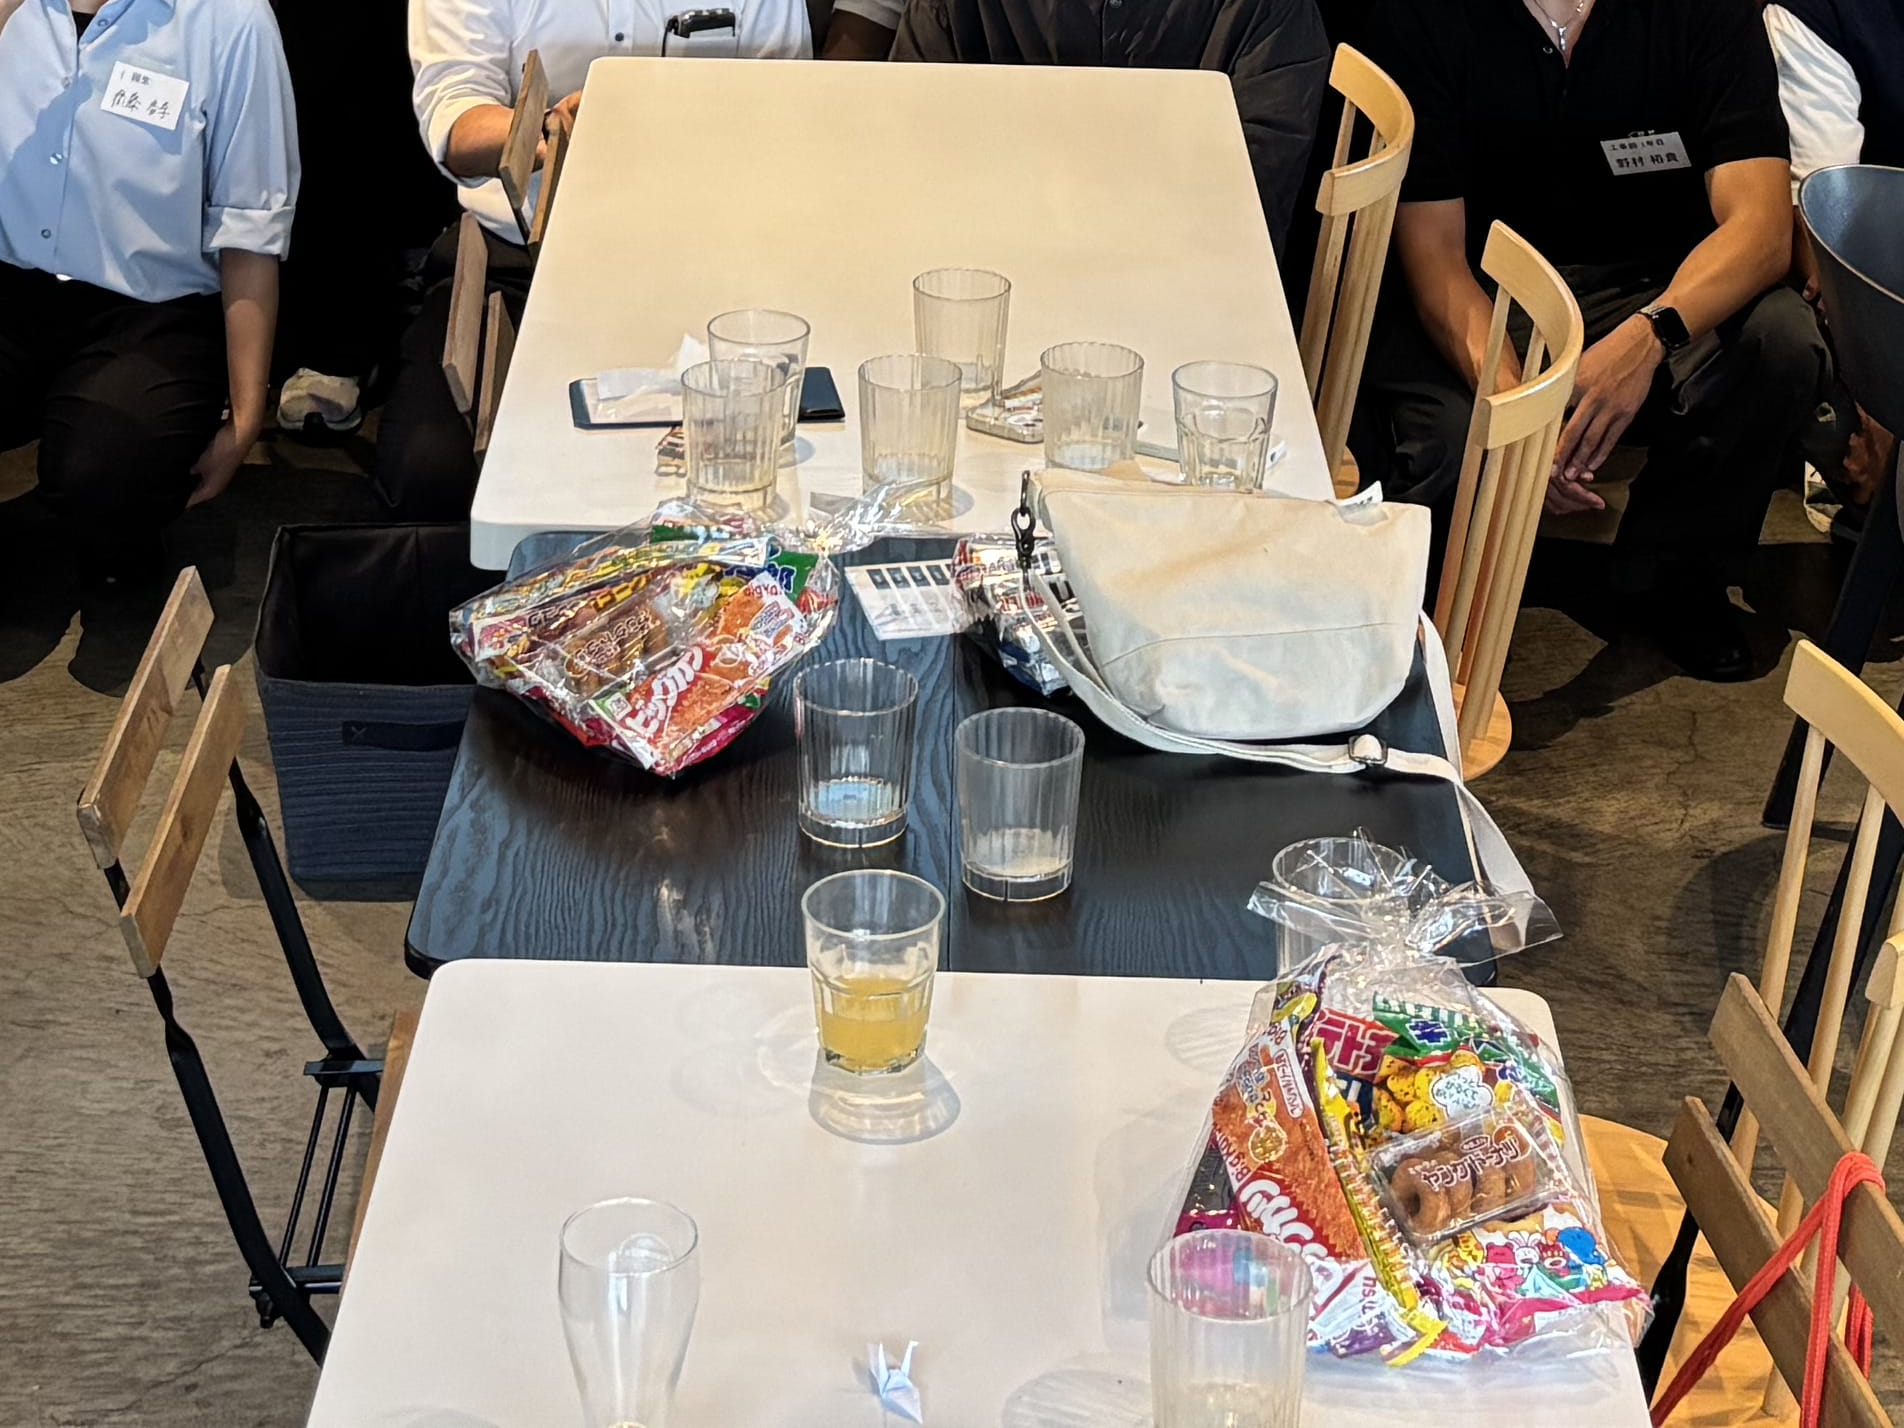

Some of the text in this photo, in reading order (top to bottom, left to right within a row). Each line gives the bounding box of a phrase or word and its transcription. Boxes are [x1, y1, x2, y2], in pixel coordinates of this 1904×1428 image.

[624, 645, 704, 736] ビッグカツ
[1421, 1134, 1520, 1193] ヤングドーナツ
